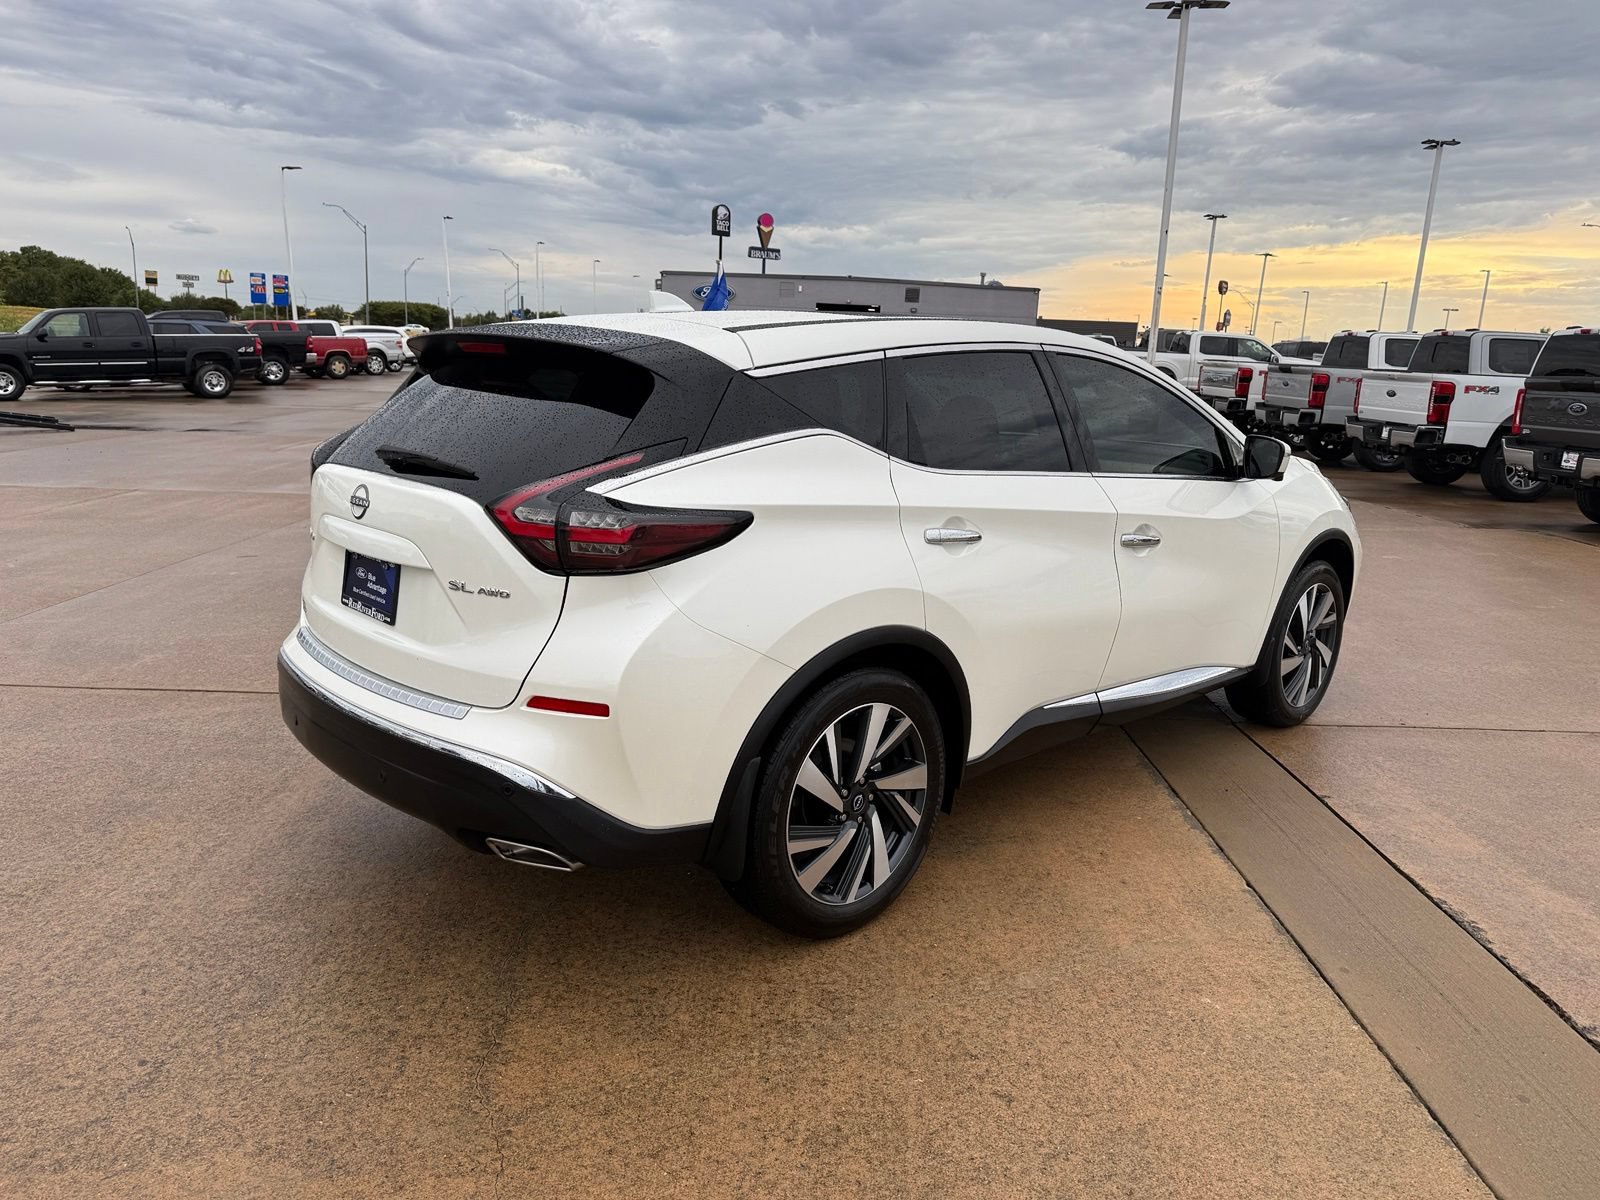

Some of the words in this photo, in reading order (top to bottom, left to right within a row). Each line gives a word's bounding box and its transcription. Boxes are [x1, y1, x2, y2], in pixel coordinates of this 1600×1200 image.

[1464, 385, 1499, 394] FX4
[448, 579, 474, 594] SL
[478, 586, 511, 598] AWD
